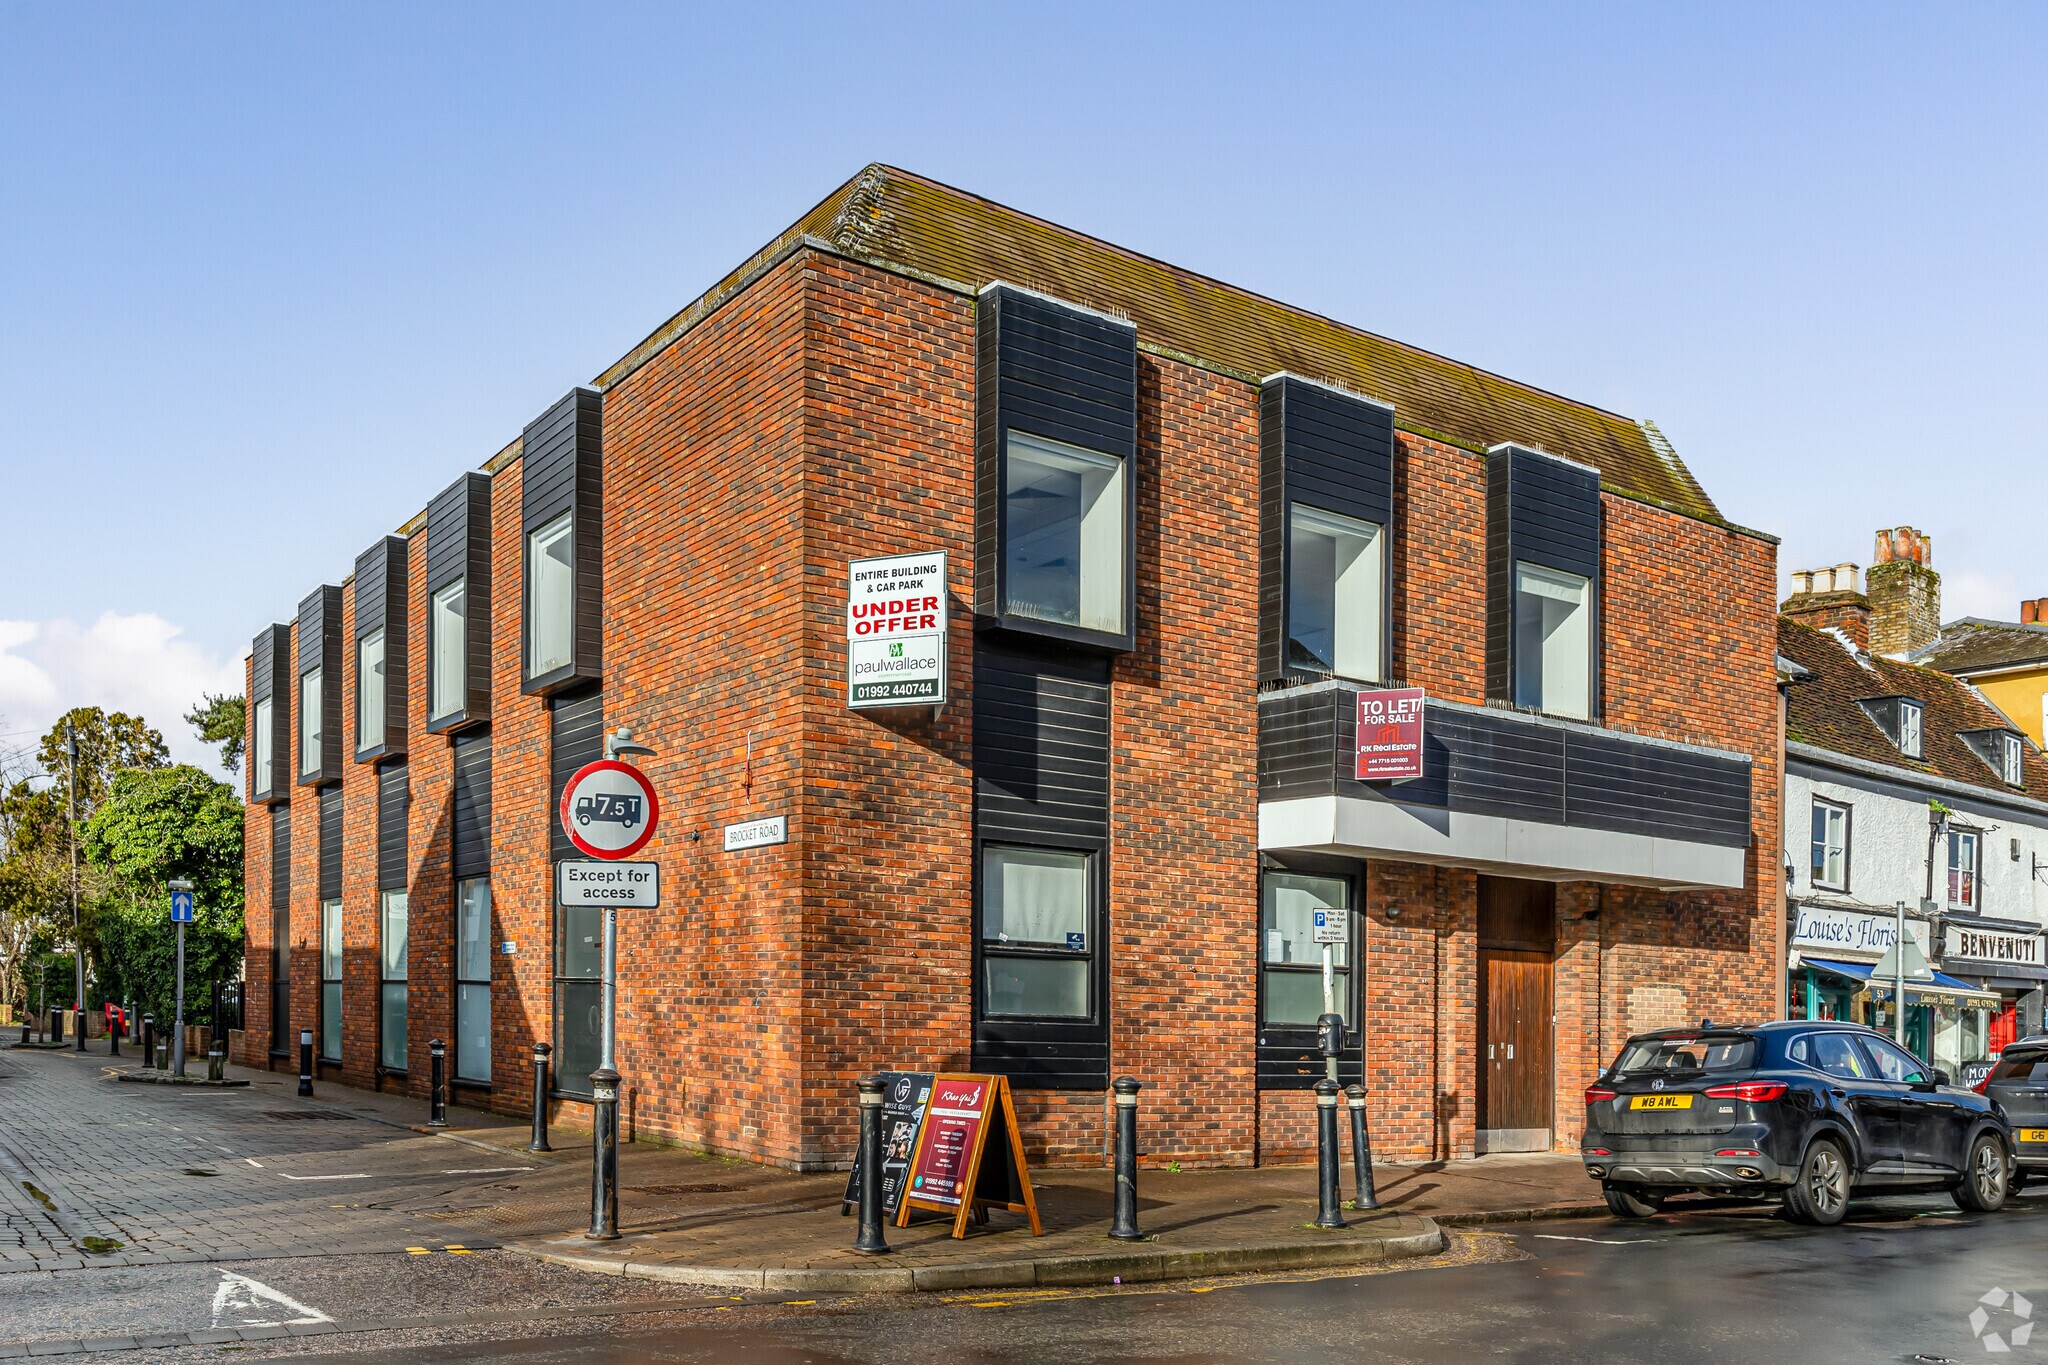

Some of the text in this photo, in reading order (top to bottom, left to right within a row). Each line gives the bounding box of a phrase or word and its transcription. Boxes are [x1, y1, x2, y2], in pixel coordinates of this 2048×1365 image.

[855, 565, 937, 581] ENTIRE BUILDING
[867, 579, 924, 593] & CAR PARK
[852, 596, 939, 618] UNDER
[855, 614, 936, 635] OFFER
[855, 657, 936, 676] paulwallace
[858, 682, 932, 698] 01992 440744
[1361, 700, 1383, 715] TO
[1364, 714, 1415, 725] FOR SALE
[1373, 744, 1391, 752] Real
[1391, 743, 1417, 751] Estate
[730, 828, 757, 843] BROCKET
[760, 825, 778, 839] ROAD
[569, 868, 650, 884] Except for
[583, 888, 635, 899] access
[610, 912, 616, 921] 5
[1317, 914, 1324, 925] P
[1796, 913, 1853, 942] Louise's
[1960, 932, 2036, 961] BENVENUTI
[1876, 989, 1884, 998] 53
[884, 1102, 898, 1110] WISE
[1642, 1097, 1678, 1107] W8 AWL
